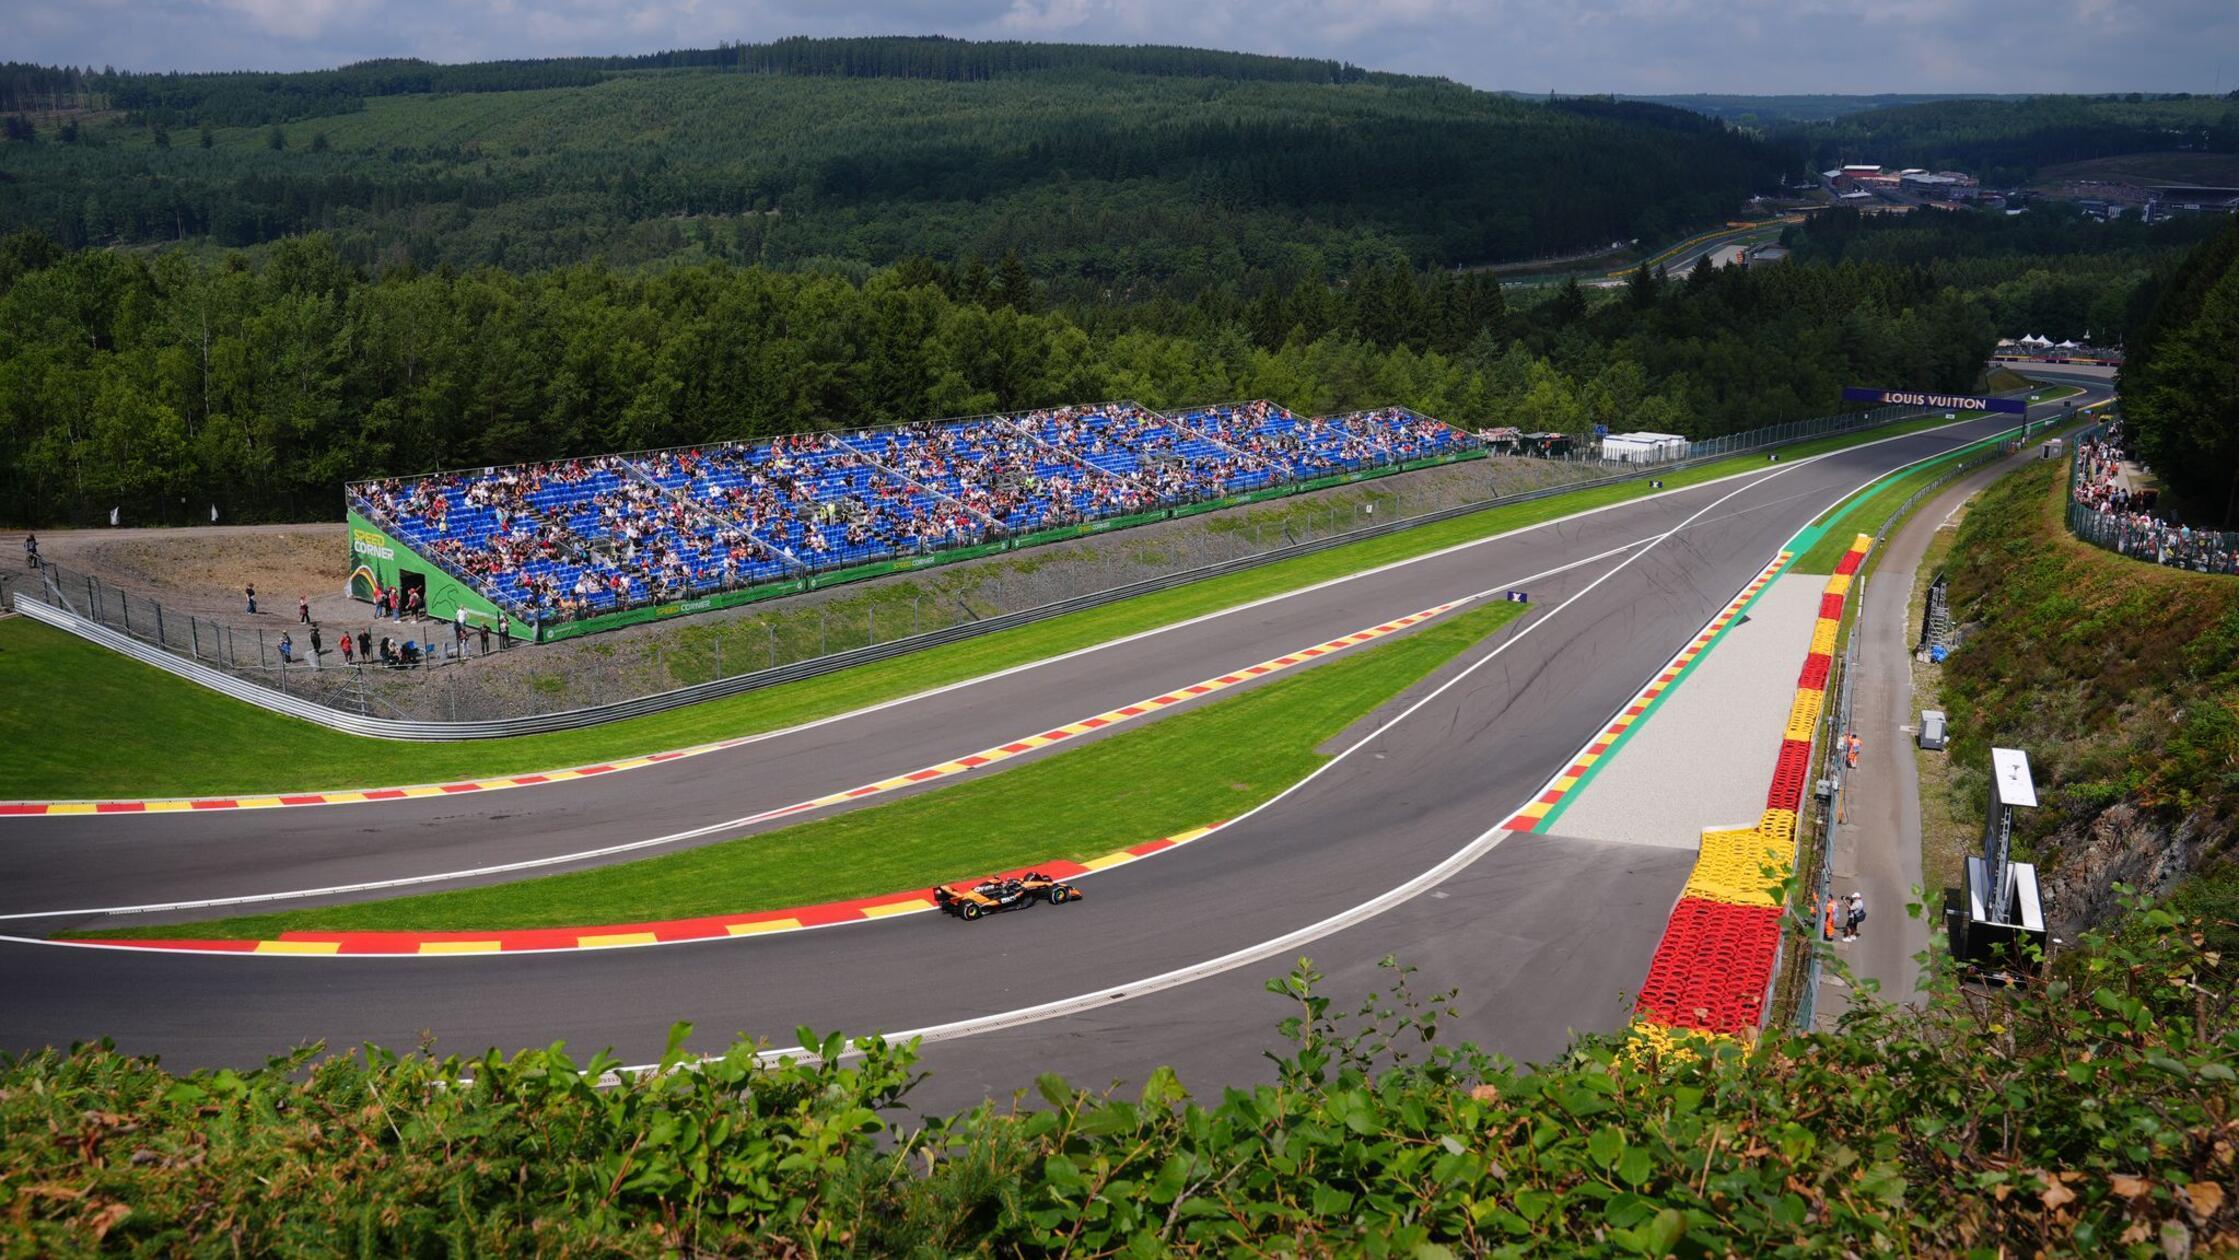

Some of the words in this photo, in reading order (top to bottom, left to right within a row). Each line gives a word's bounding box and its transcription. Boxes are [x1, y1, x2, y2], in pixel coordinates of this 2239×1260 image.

[1885, 392, 1925, 405] LOUIS
[1928, 395, 1986, 410] VUITTON
[353, 528, 385, 547] SPEED
[353, 540, 394, 561] CORNER
